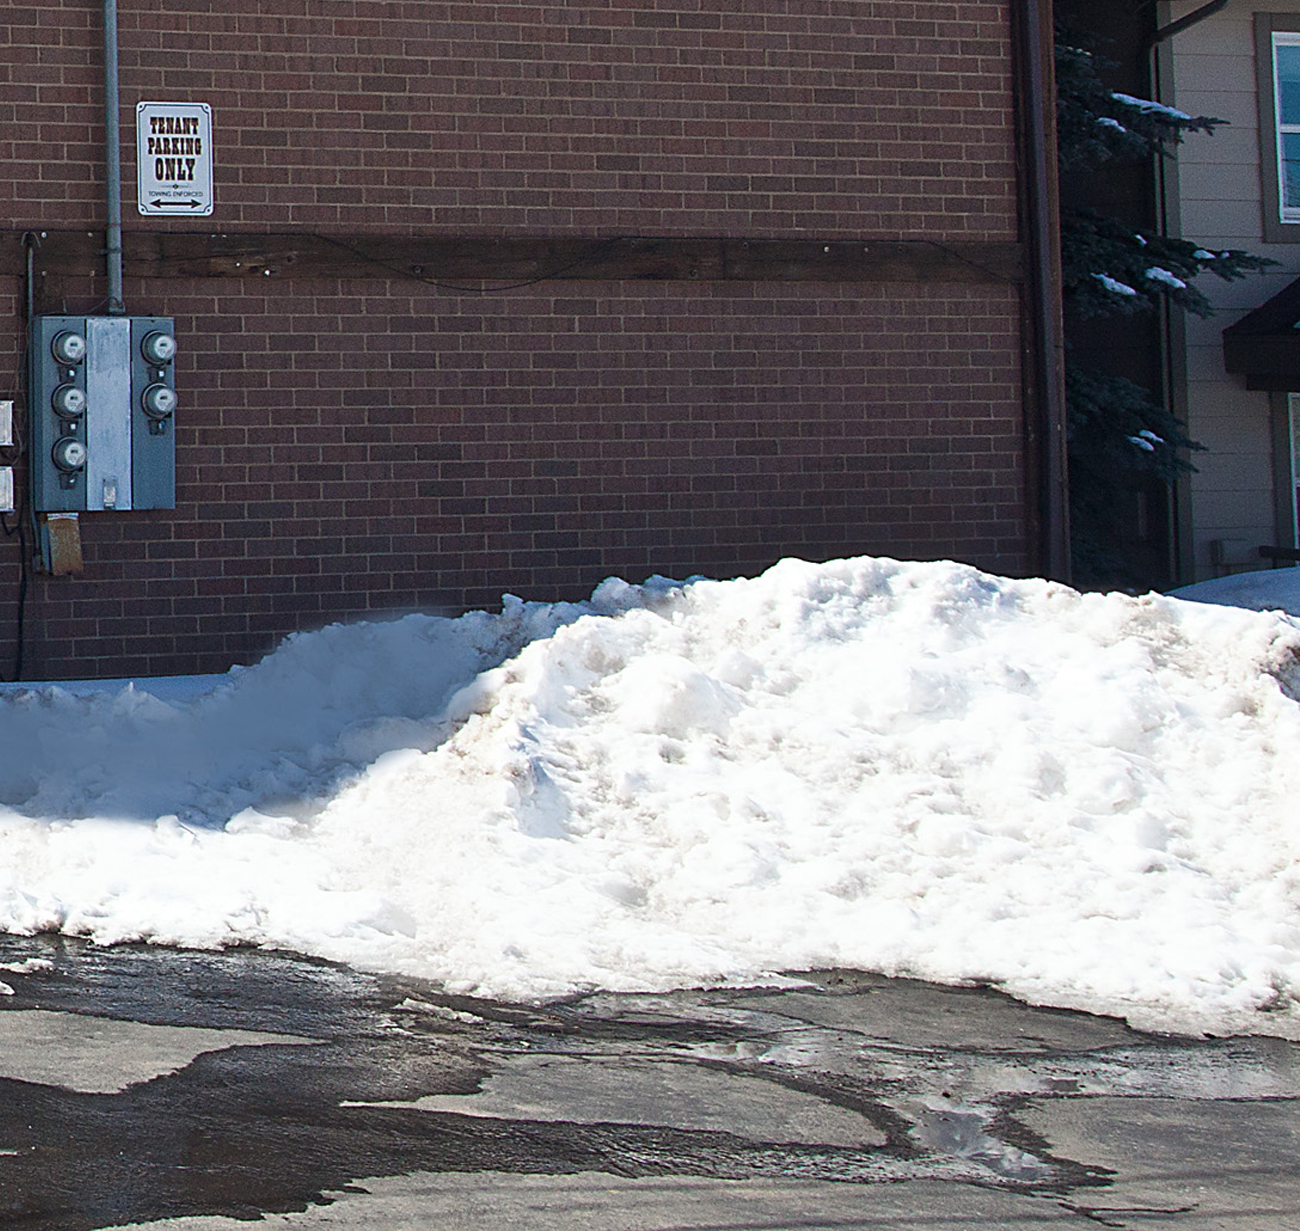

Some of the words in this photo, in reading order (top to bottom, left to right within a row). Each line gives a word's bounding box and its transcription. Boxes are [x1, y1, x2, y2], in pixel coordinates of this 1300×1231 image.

[150, 117, 199, 135] TENANT
[147, 137, 202, 155] PARKING
[155, 157, 196, 181] ONLY
[172, 190, 204, 198] ENFORCED
